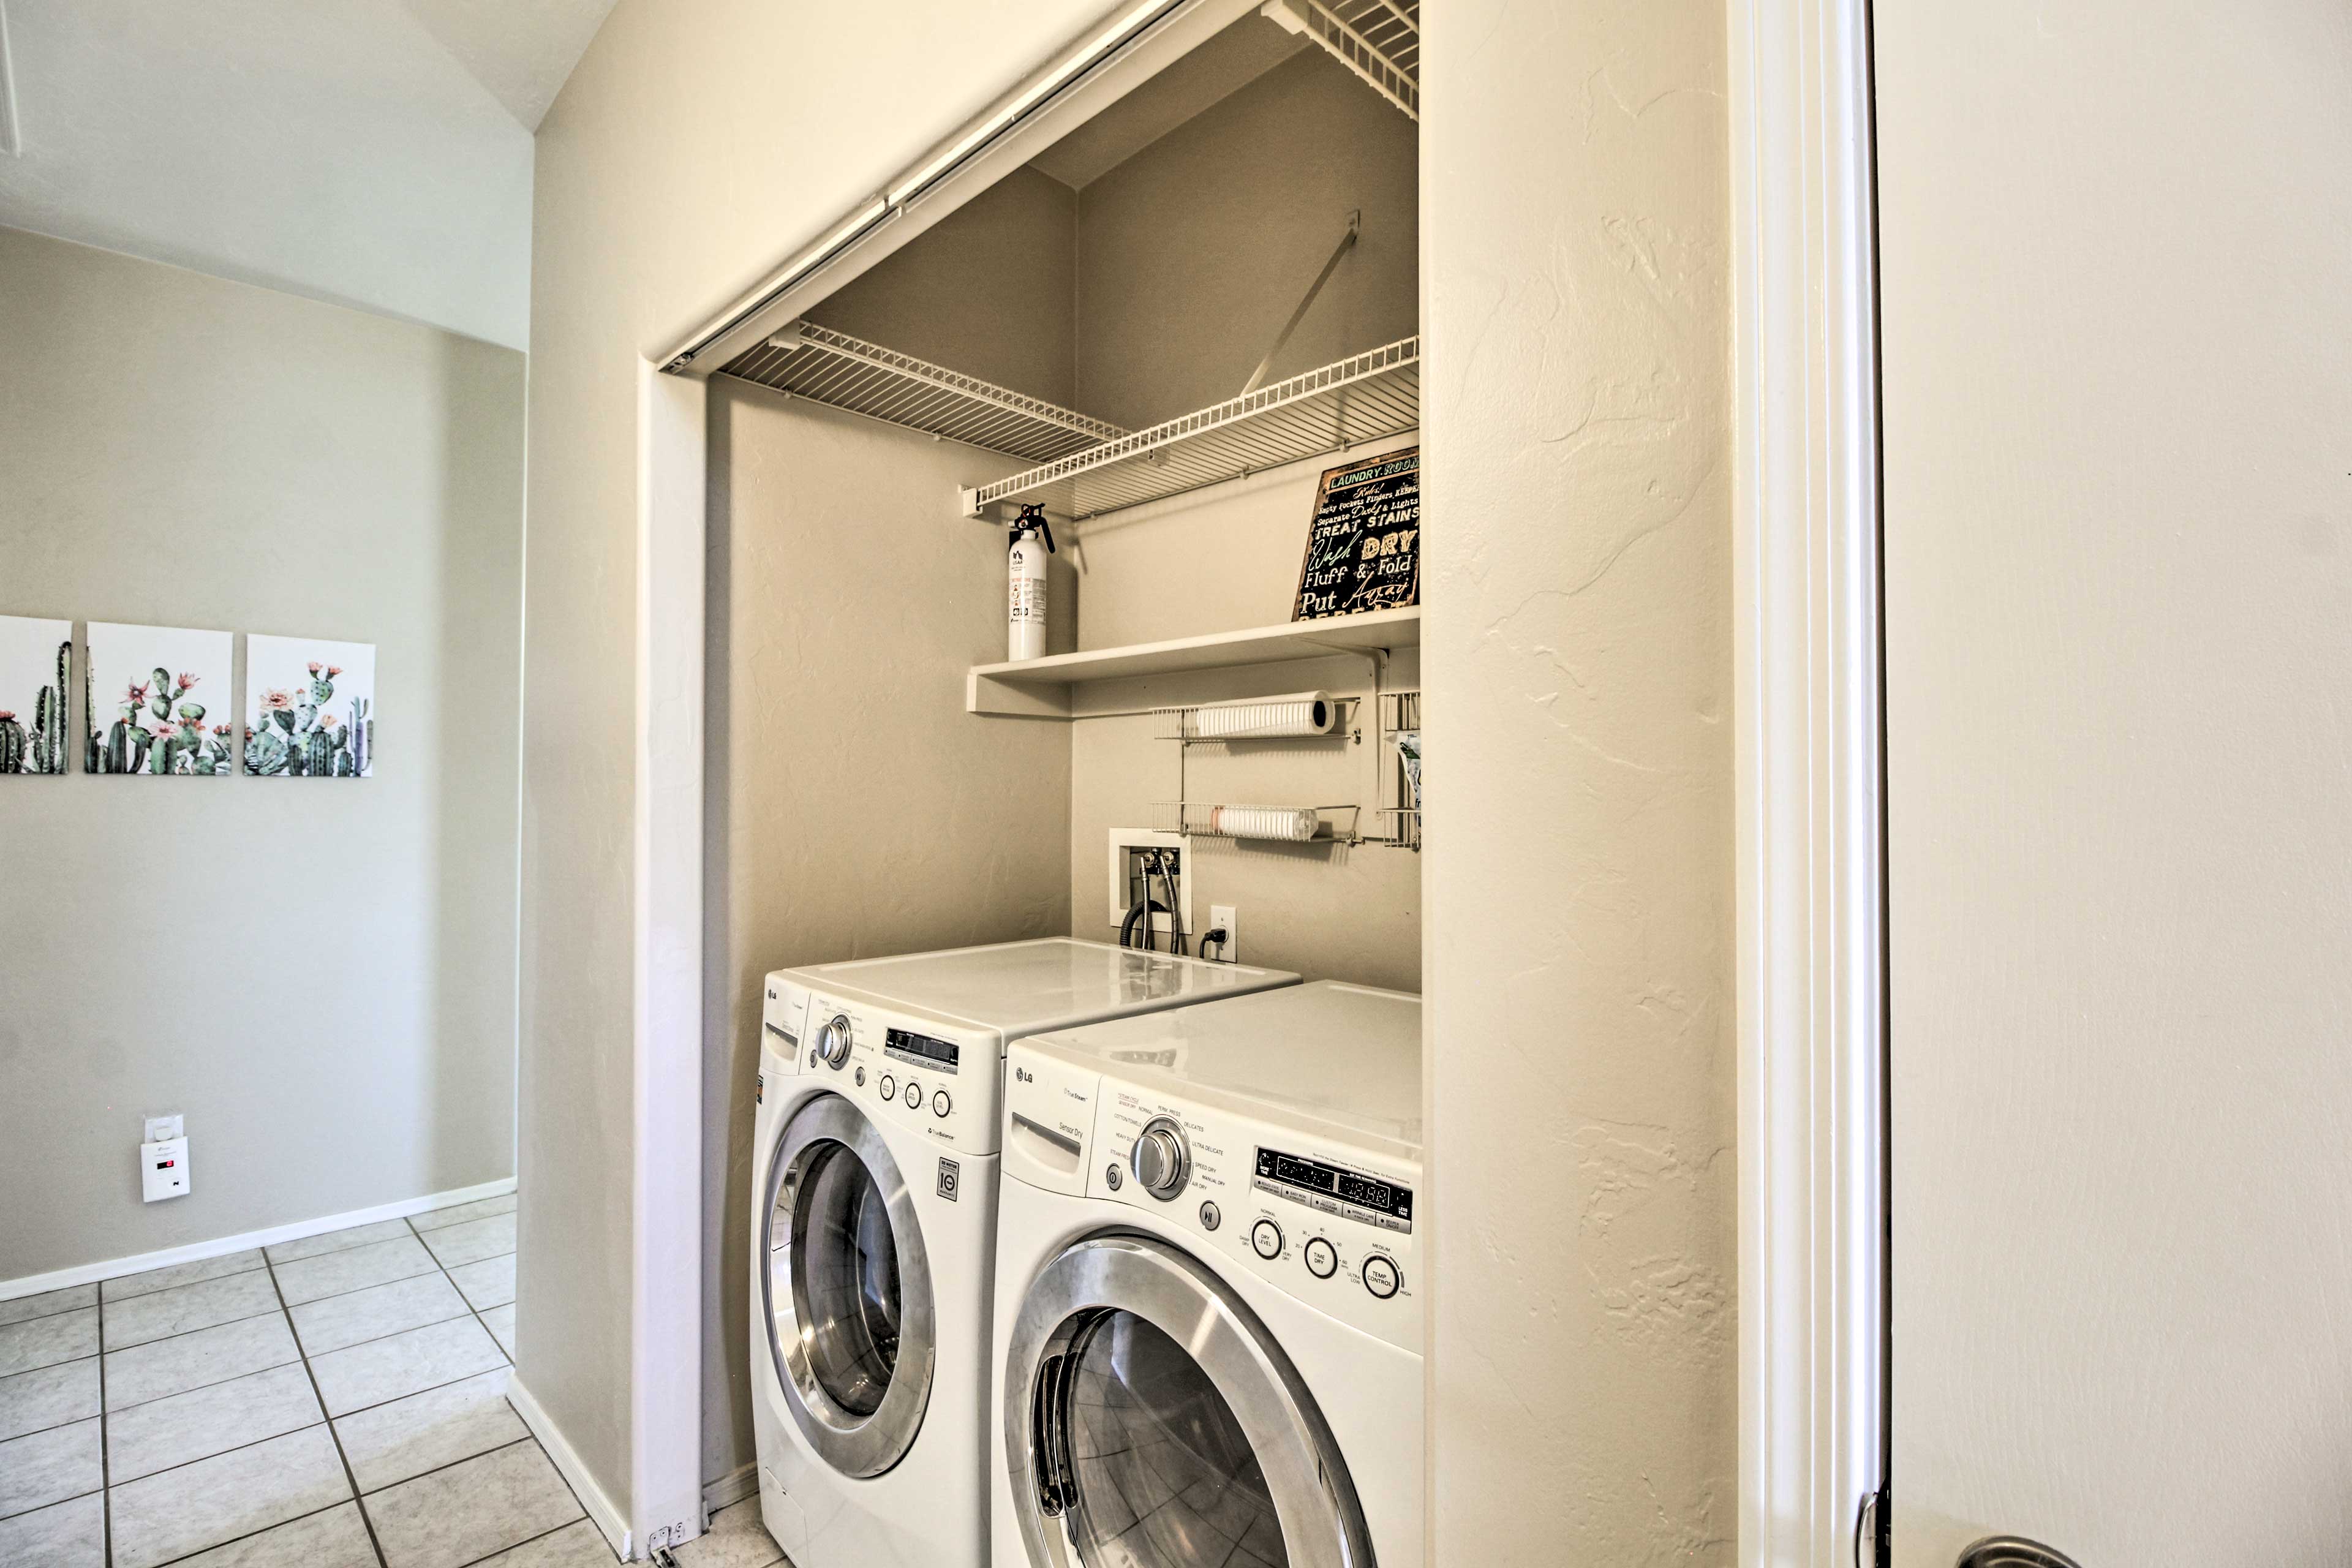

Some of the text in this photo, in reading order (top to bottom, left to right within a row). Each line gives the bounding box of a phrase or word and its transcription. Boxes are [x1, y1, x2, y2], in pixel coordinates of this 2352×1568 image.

[1317, 514, 1351, 526] Separate
[1390, 498, 1419, 510] Lights
[1315, 507, 1419, 540] TREAT STAINS
[1308, 530, 1418, 571] Wash DRY
[1304, 555, 1412, 588] Fluff & Fold
[1300, 590, 1337, 614] Put
[1342, 571, 1409, 608] Away
[1139, 1106, 1153, 1115] NORMAL
[1059, 1122, 1083, 1139] Sensor Dry
[1184, 1121, 1204, 1132] DELICATES
[1192, 1141, 1224, 1156] ULTRA DELICATE
[1195, 1162, 1207, 1170] SPEED
[1202, 1175, 1216, 1184] MANUAL
[1261, 1208, 1276, 1217] NORMAL
[1372, 1243, 1390, 1252] MEDIUM
[1367, 1275, 1392, 1287] CONTROL
